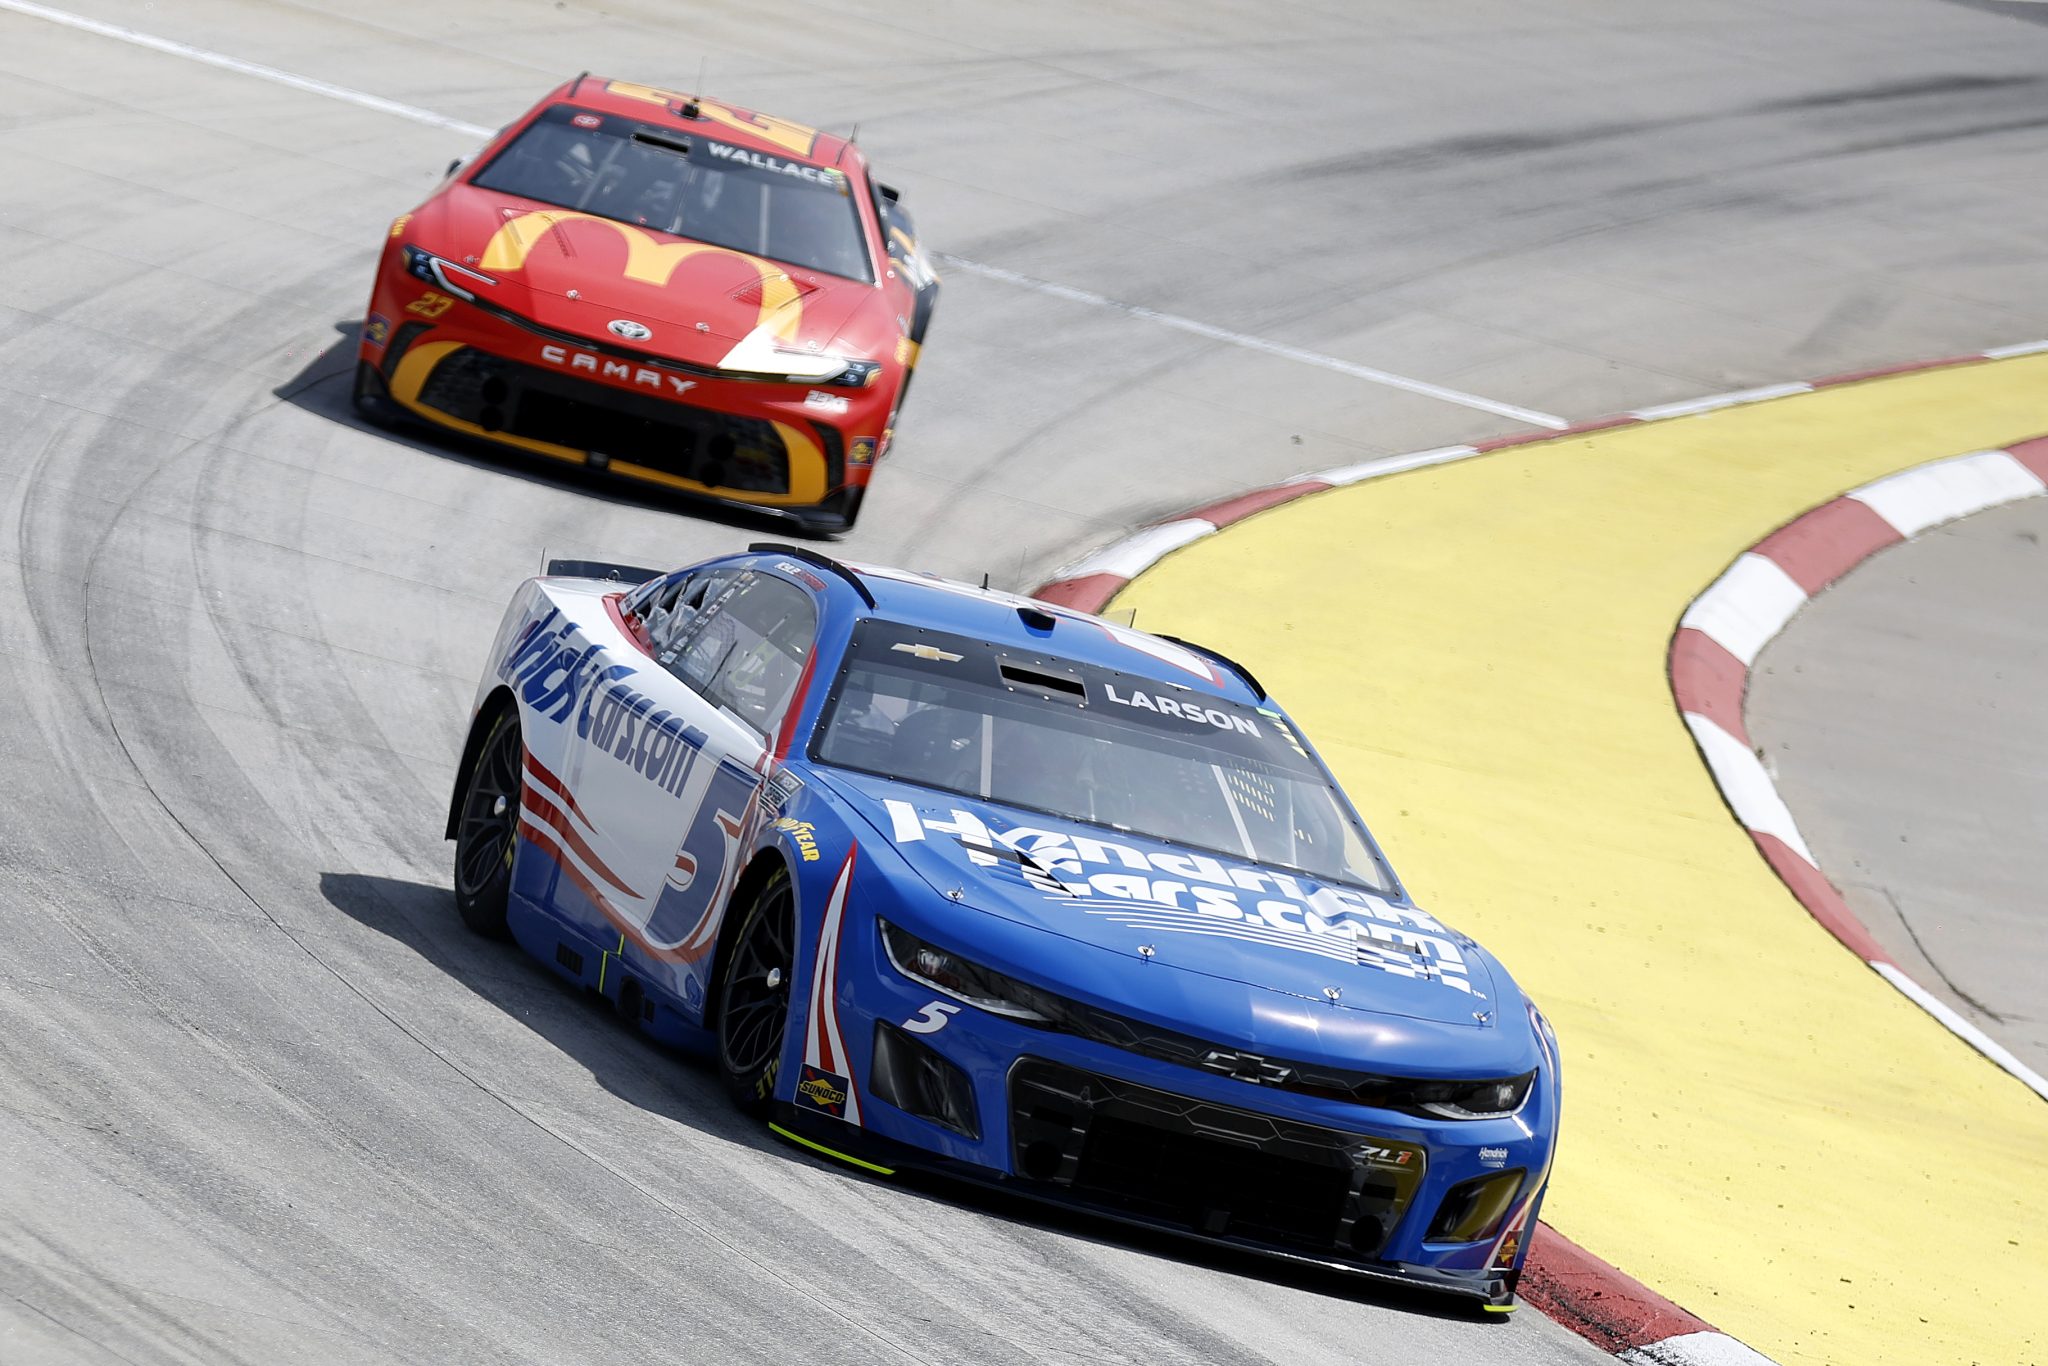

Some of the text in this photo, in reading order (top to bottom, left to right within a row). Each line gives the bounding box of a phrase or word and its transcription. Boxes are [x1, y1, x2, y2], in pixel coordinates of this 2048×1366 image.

[707, 141, 838, 188] WALLACE
[405, 291, 454, 317] 23
[541, 345, 699, 395] CAMRY
[1104, 684, 1262, 739] LARSON
[644, 757, 763, 947] 5
[882, 799, 1447, 934] Hendrick
[1020, 862, 1471, 988] Cars.com
[901, 1000, 962, 1034] 5
[801, 1081, 846, 1103] SUNOCO
